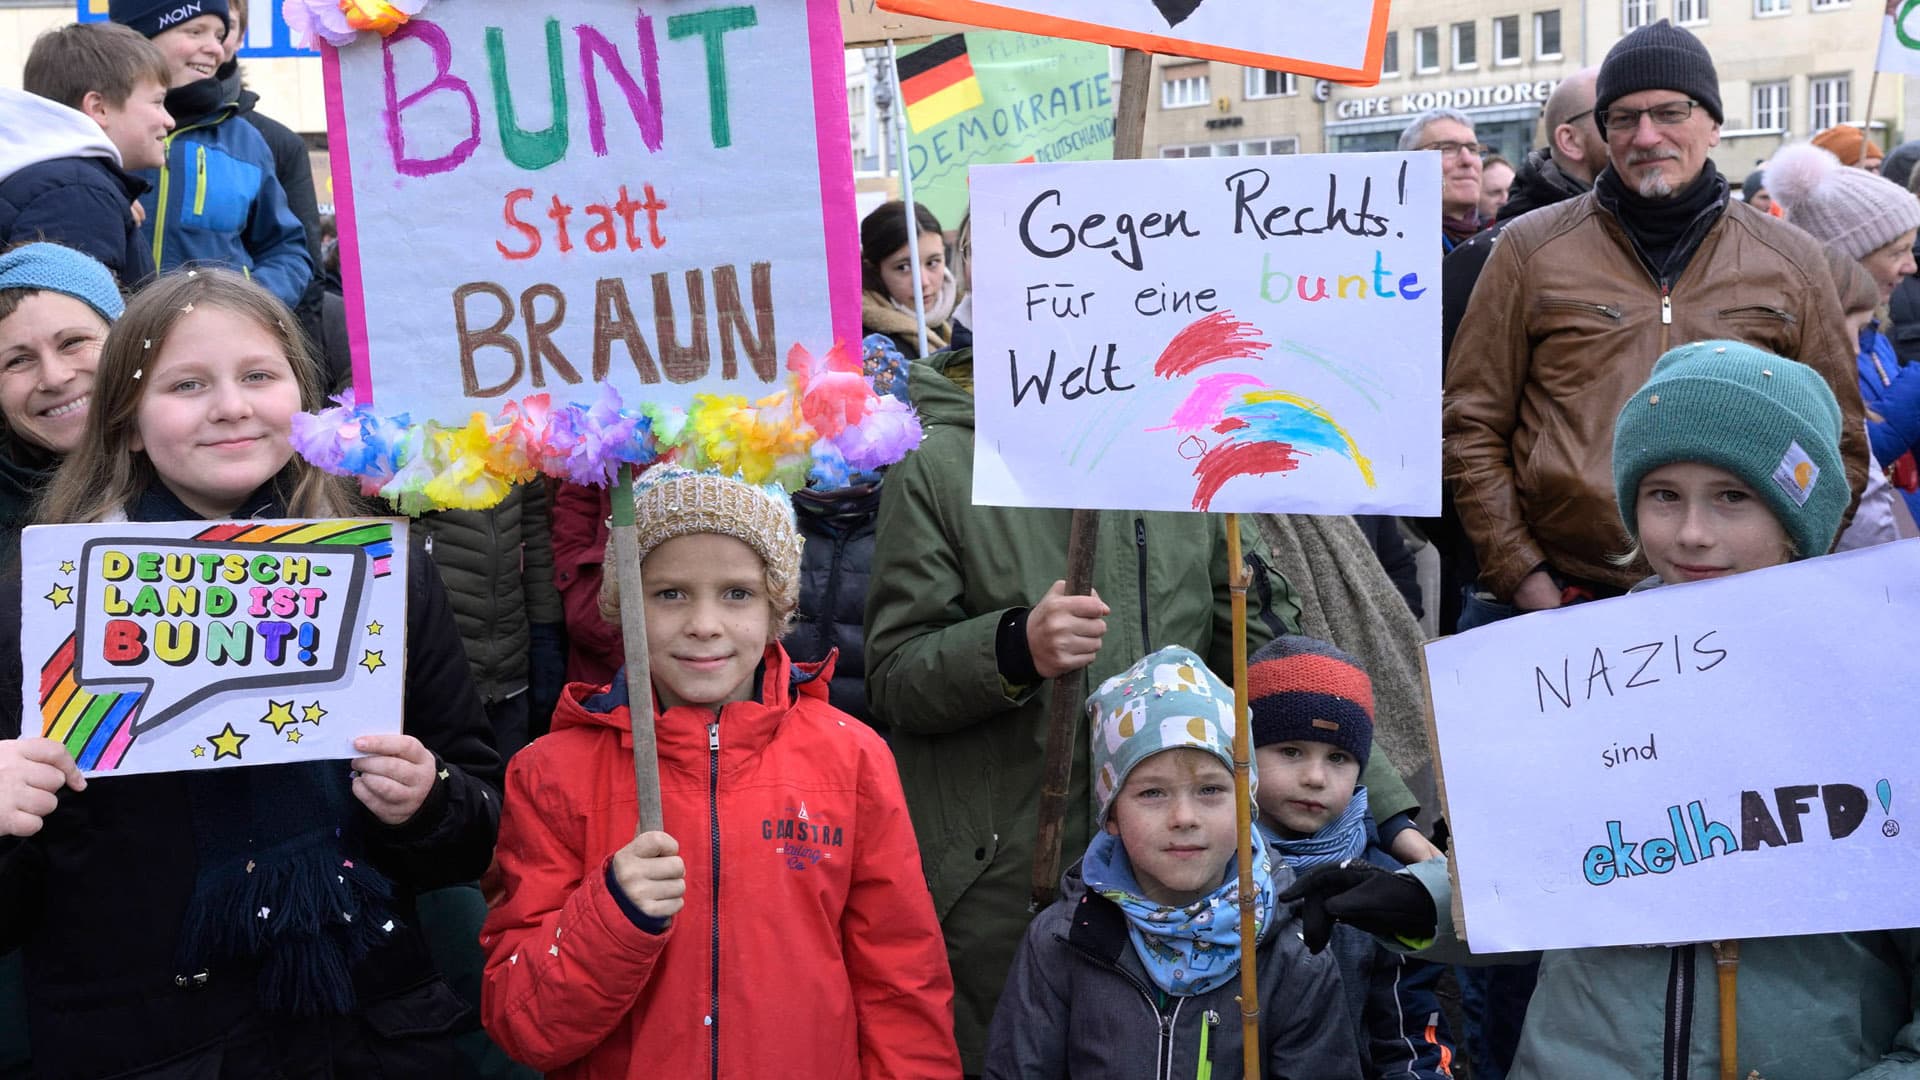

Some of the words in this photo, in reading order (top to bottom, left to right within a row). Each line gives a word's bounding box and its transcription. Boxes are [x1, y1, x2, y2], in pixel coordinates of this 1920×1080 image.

[158, 2, 202, 29] MOIN
[382, 5, 758, 177] BUNT
[1035, 118, 1115, 162] DEUTSCHLAND
[496, 182, 667, 260] Statt
[1019, 189, 1201, 271] Gegen
[1225, 160, 1407, 240] Rechts!
[1026, 284, 1096, 321] Für
[1135, 282, 1218, 316] eine
[1260, 250, 1427, 303] bunte
[452, 261, 778, 398] BRAUN
[1009, 344, 1136, 407] Welt
[102, 551, 331, 584] DEUTSCH-
[104, 585, 238, 617] LAND
[248, 587, 328, 618] IST
[103, 620, 319, 667] BUNT!
[1535, 630, 1728, 713] NAZIS
[1601, 733, 1658, 768] sind
[762, 819, 844, 847] GAASTRA
[1583, 778, 1900, 886] ekelhAFD!
